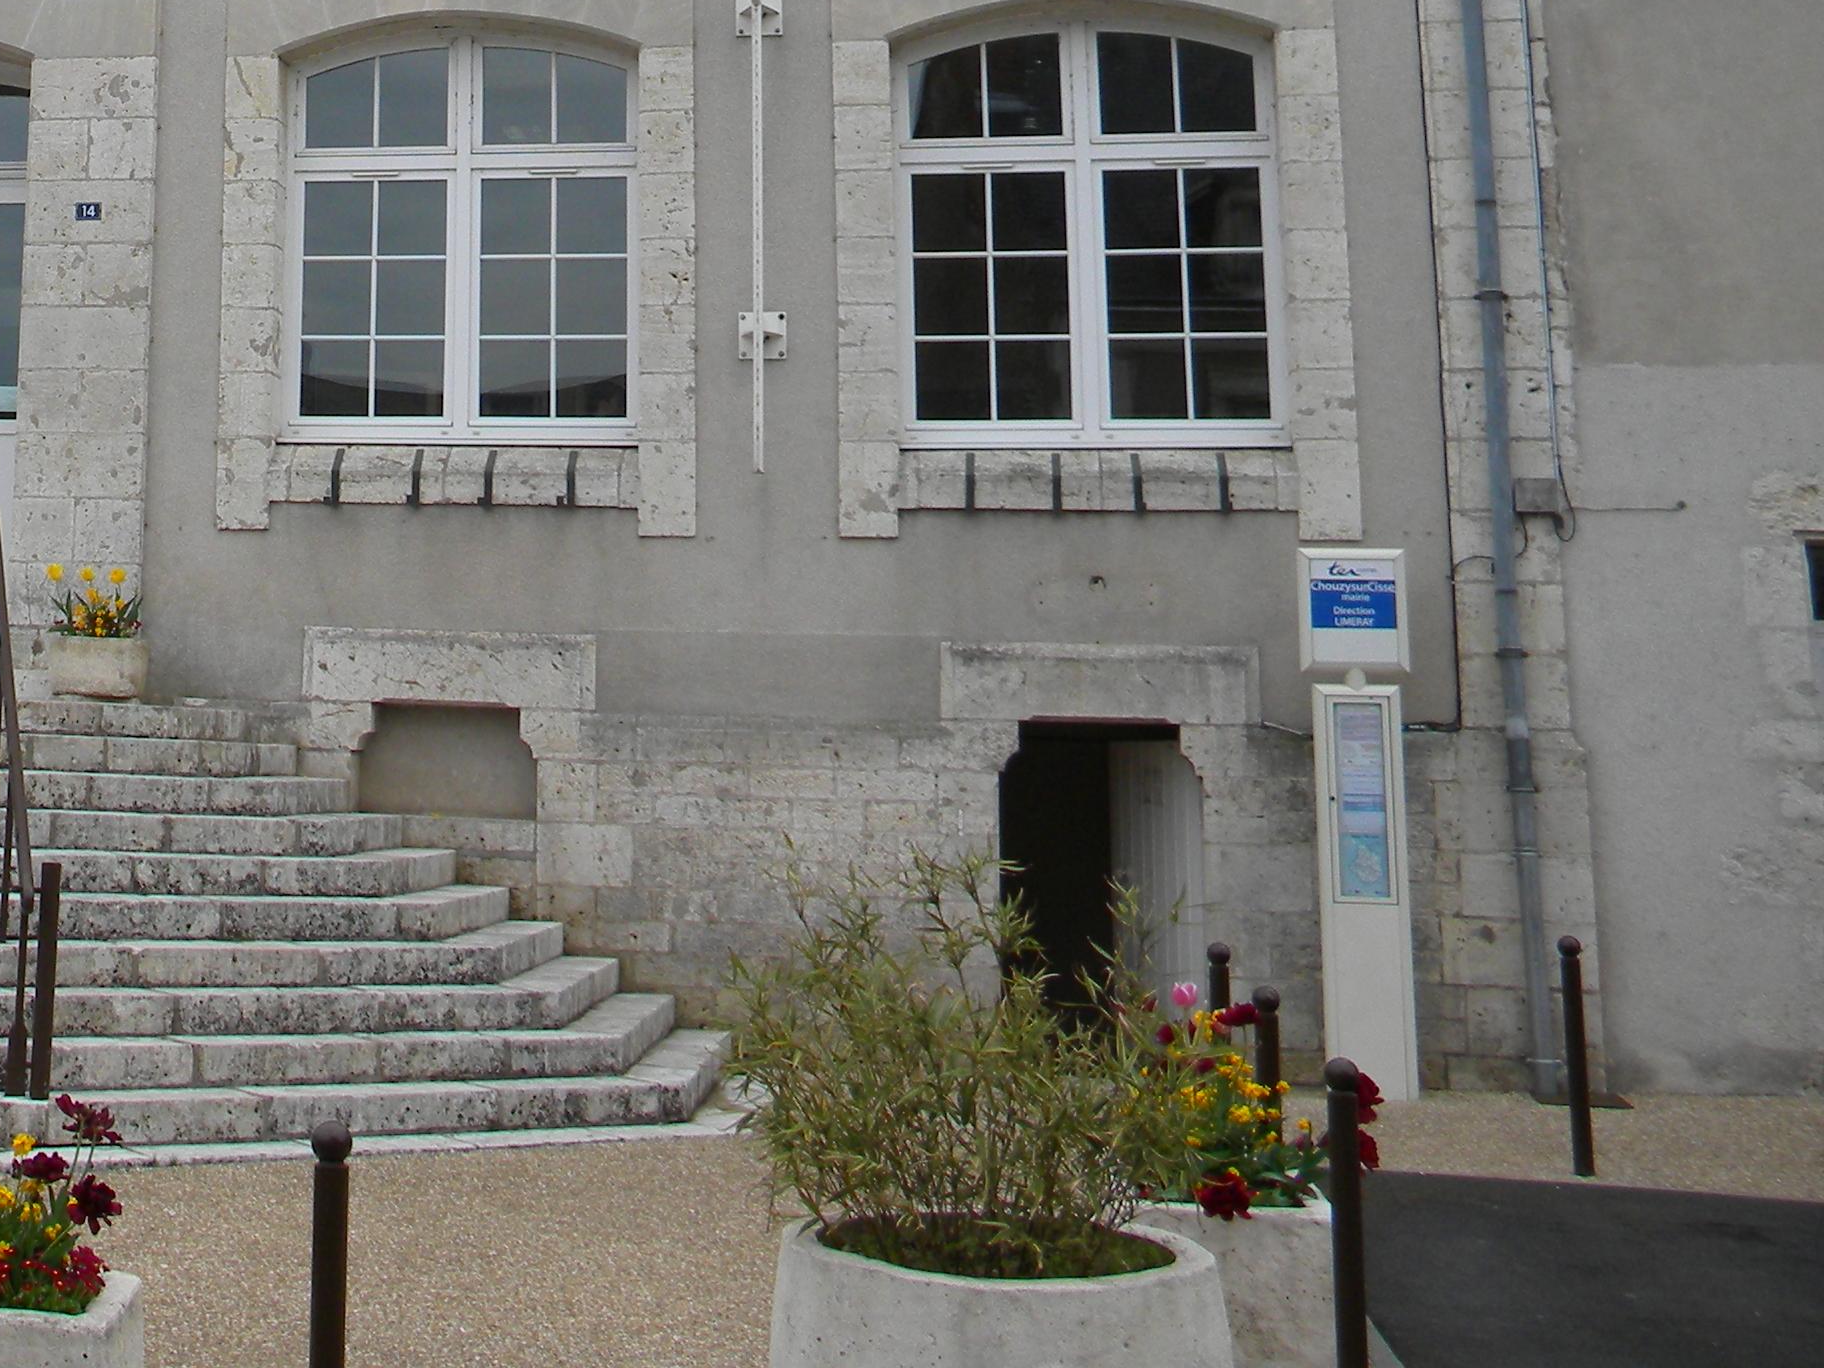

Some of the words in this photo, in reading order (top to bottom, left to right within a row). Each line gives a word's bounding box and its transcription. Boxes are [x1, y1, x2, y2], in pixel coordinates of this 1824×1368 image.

[82, 205, 96, 217] 14
[1341, 593, 1370, 601] mairie
[1333, 606, 1375, 615] Direction
[1335, 616, 1375, 626] LIMERAY
